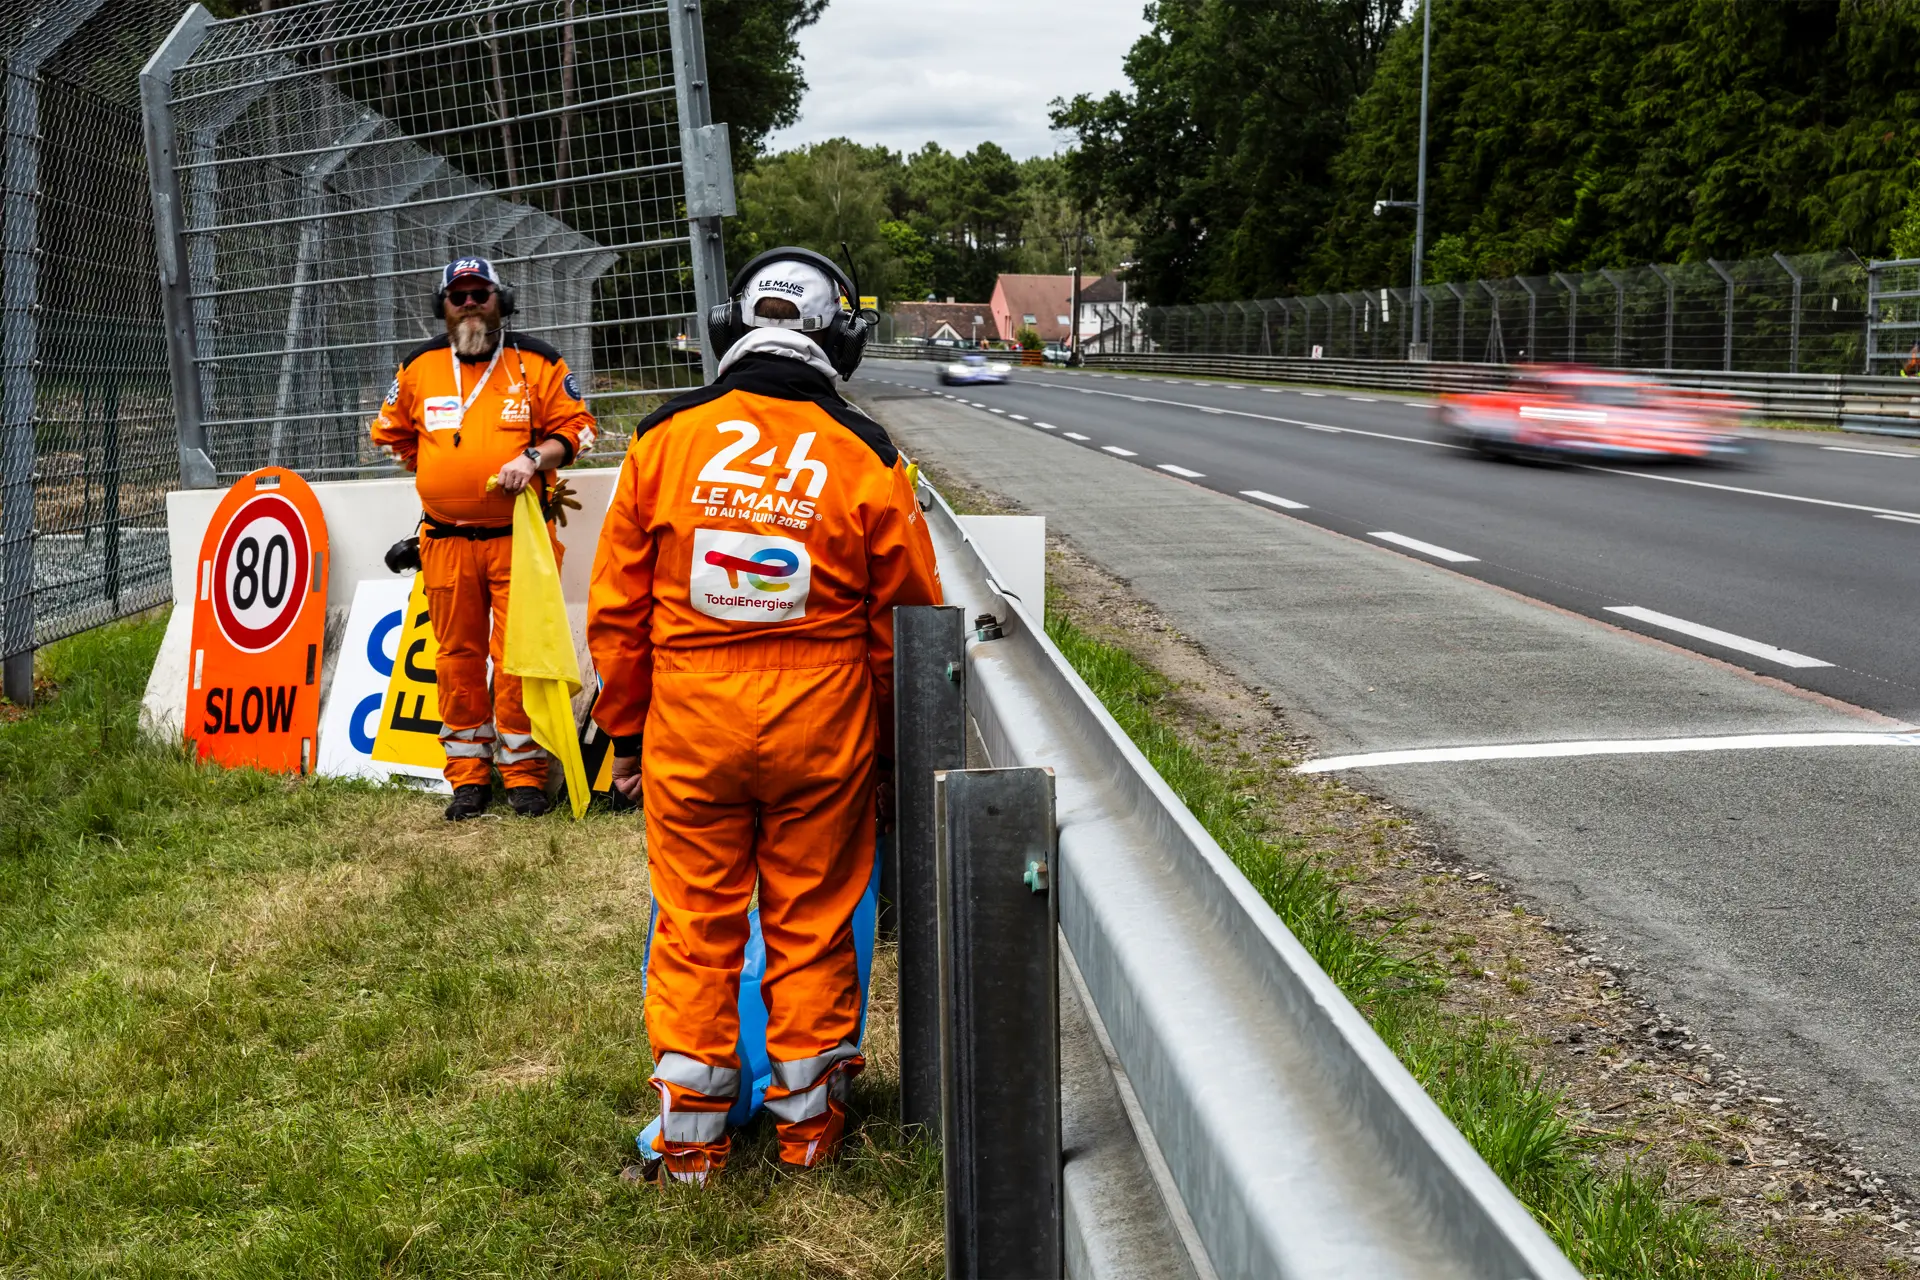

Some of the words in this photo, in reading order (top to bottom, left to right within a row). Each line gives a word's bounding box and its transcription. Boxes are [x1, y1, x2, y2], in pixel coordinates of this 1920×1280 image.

[773, 281, 805, 293] MANS
[501, 399, 530, 414] 24h
[697, 420, 828, 498] 24h
[691, 486, 728, 505] LE
[704, 506, 718, 517] 10
[720, 507, 736, 518] AU
[738, 508, 750, 520] 14
[751, 512, 777, 524] JUIN
[777, 515, 808, 530] 2026
[232, 534, 289, 611] 80
[704, 593, 794, 612] TotalEnergies
[390, 585, 444, 735] FC
[203, 685, 298, 735] SLOW
